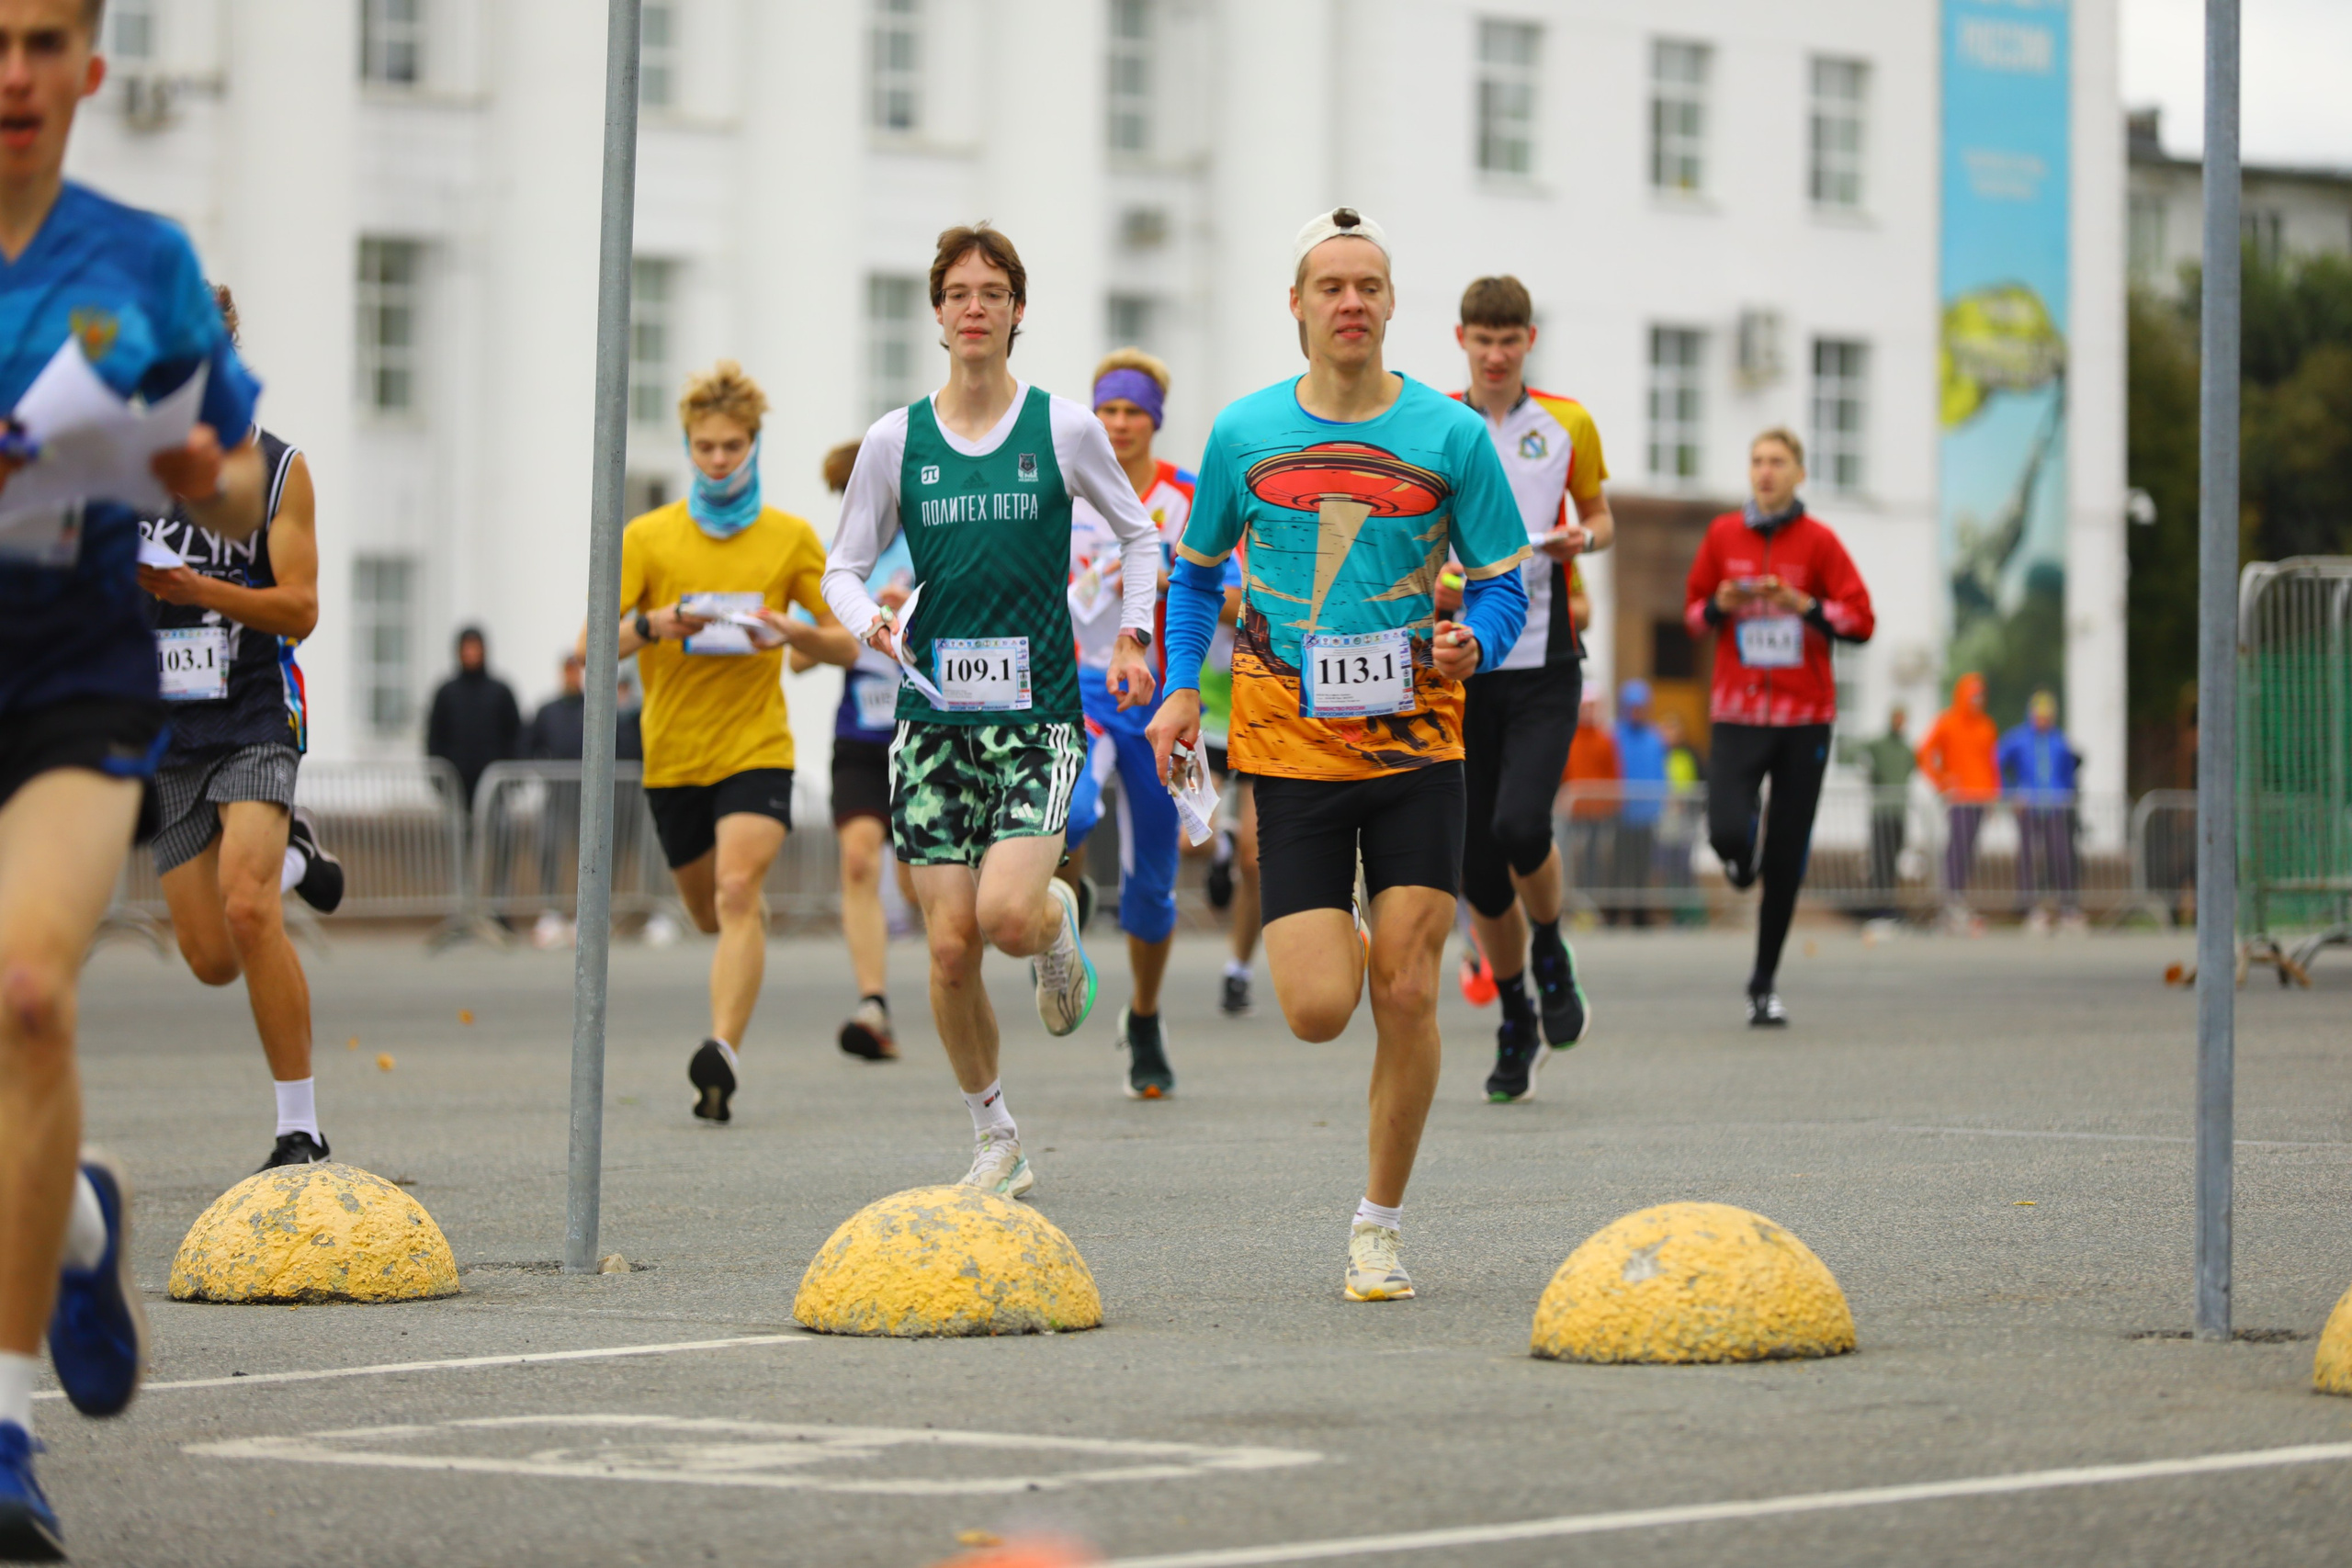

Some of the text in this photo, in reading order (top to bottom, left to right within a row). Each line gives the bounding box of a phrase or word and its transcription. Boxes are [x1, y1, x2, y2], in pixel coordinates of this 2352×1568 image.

[922, 492, 1038, 527] ПОЛИТЕХ ПЕТРА
[157, 647, 214, 673] 103.1
[945, 658, 1010, 682] 109.1
[1317, 653, 1396, 684] 113.1
